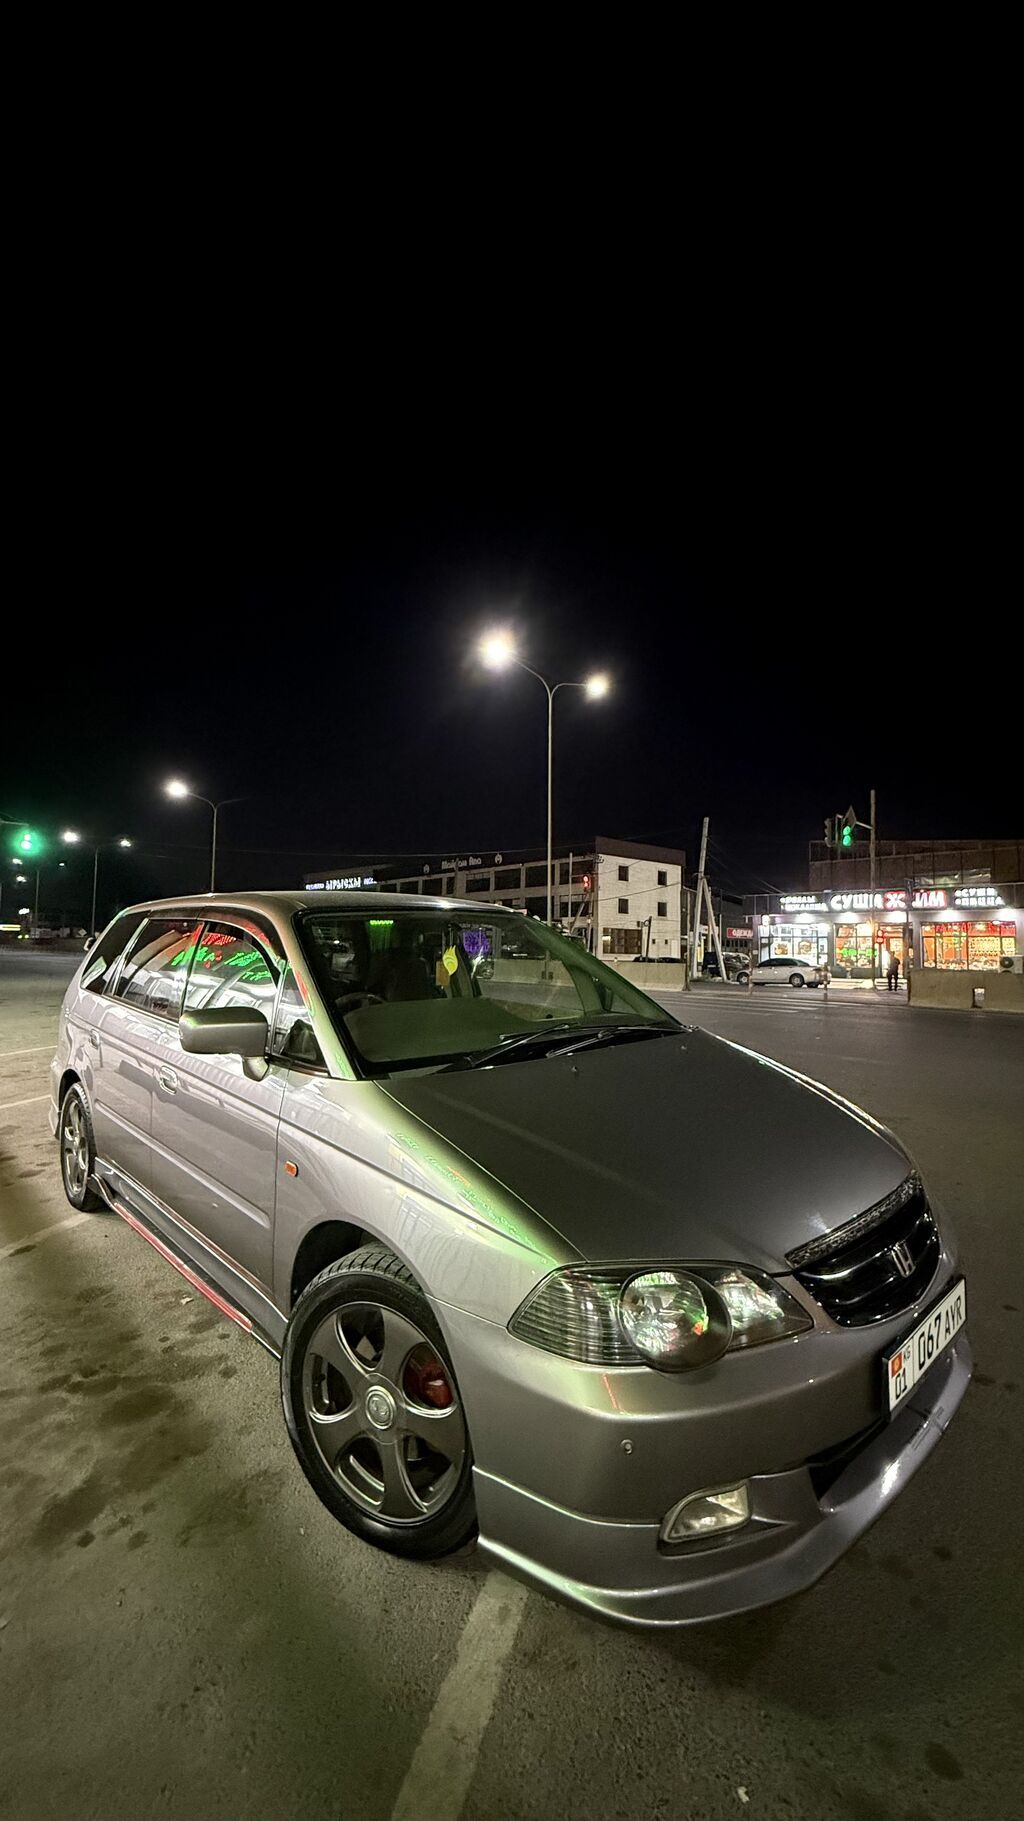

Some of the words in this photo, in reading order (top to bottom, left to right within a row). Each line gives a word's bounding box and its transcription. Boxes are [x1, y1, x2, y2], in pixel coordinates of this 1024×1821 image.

[831, 892, 883, 911] СУШИ
[961, 896, 1004, 906] ПИЦЦА
[895, 1366, 908, 1401] 01
[917, 1312, 942, 1372] 067
[944, 1294, 963, 1341] AYR
